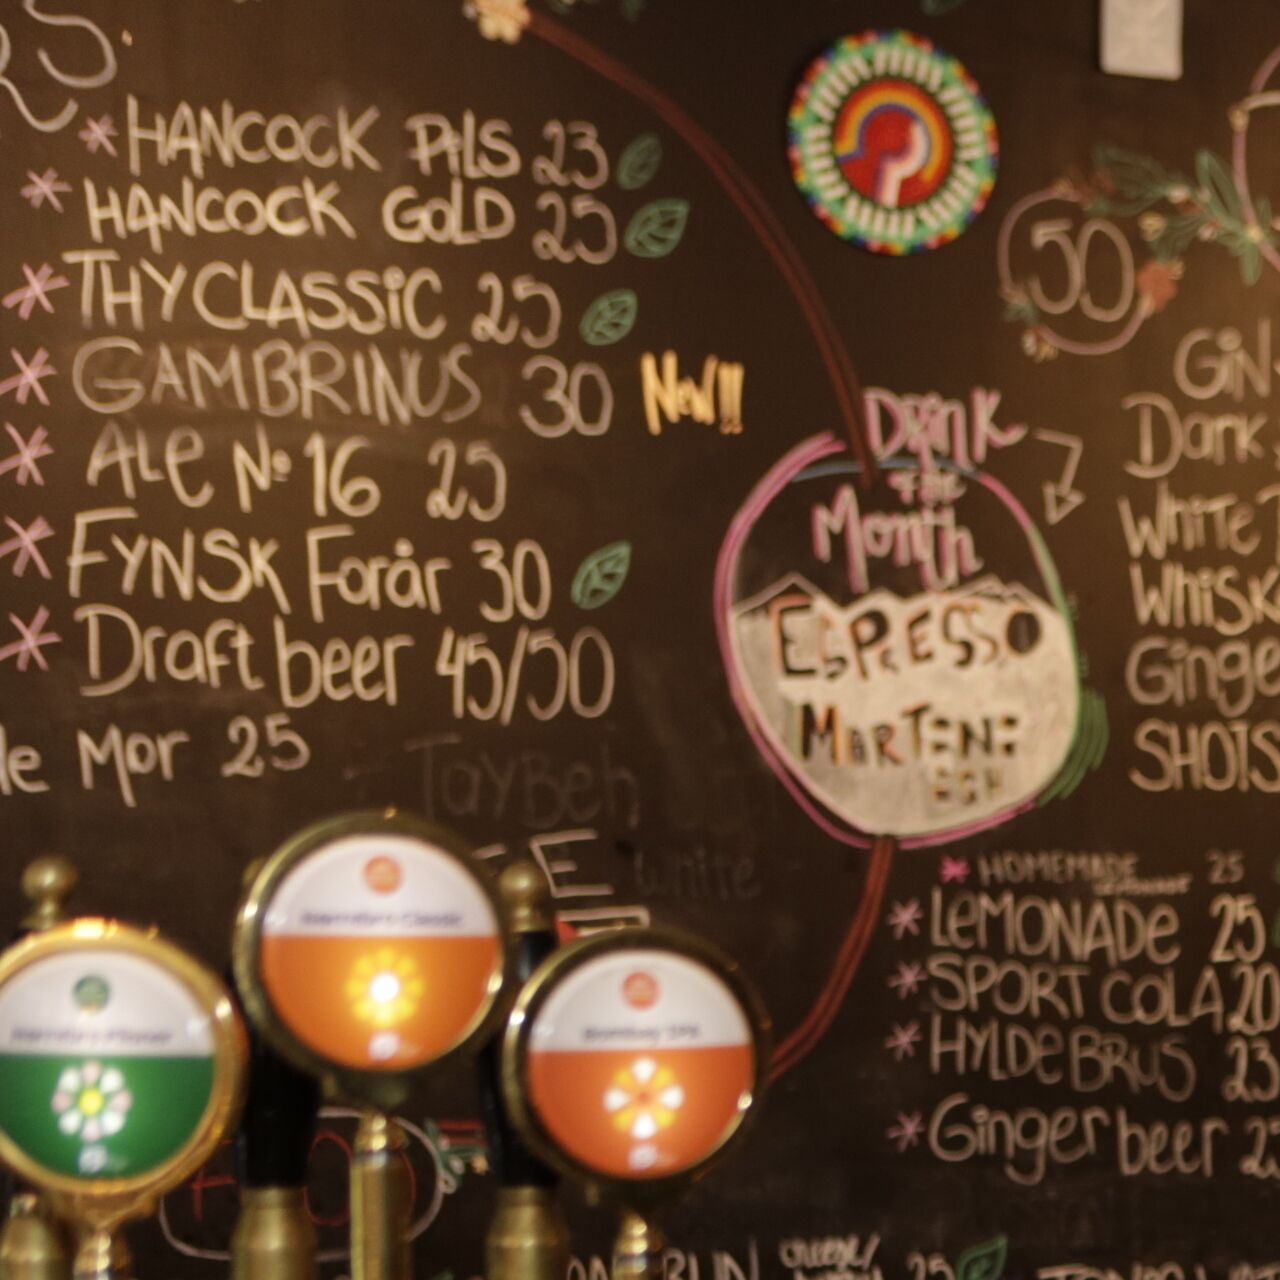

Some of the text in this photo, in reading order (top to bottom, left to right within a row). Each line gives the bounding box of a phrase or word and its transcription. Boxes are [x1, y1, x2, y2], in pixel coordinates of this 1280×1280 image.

[127, 94, 381, 179] HANCOCK
[83, 176, 357, 254] HANCOCK
[72, 336, 613, 437] GAMBRINUS 30
[471, 538, 552, 623] 30
[273, 614, 414, 708] beer
[221, 712, 311, 779] 25
[1209, 891, 1267, 965] 25
[925, 951, 1092, 1021] SPORT
[1100, 966, 1225, 1036] COLA
[1115, 1103, 1230, 1178] beer
